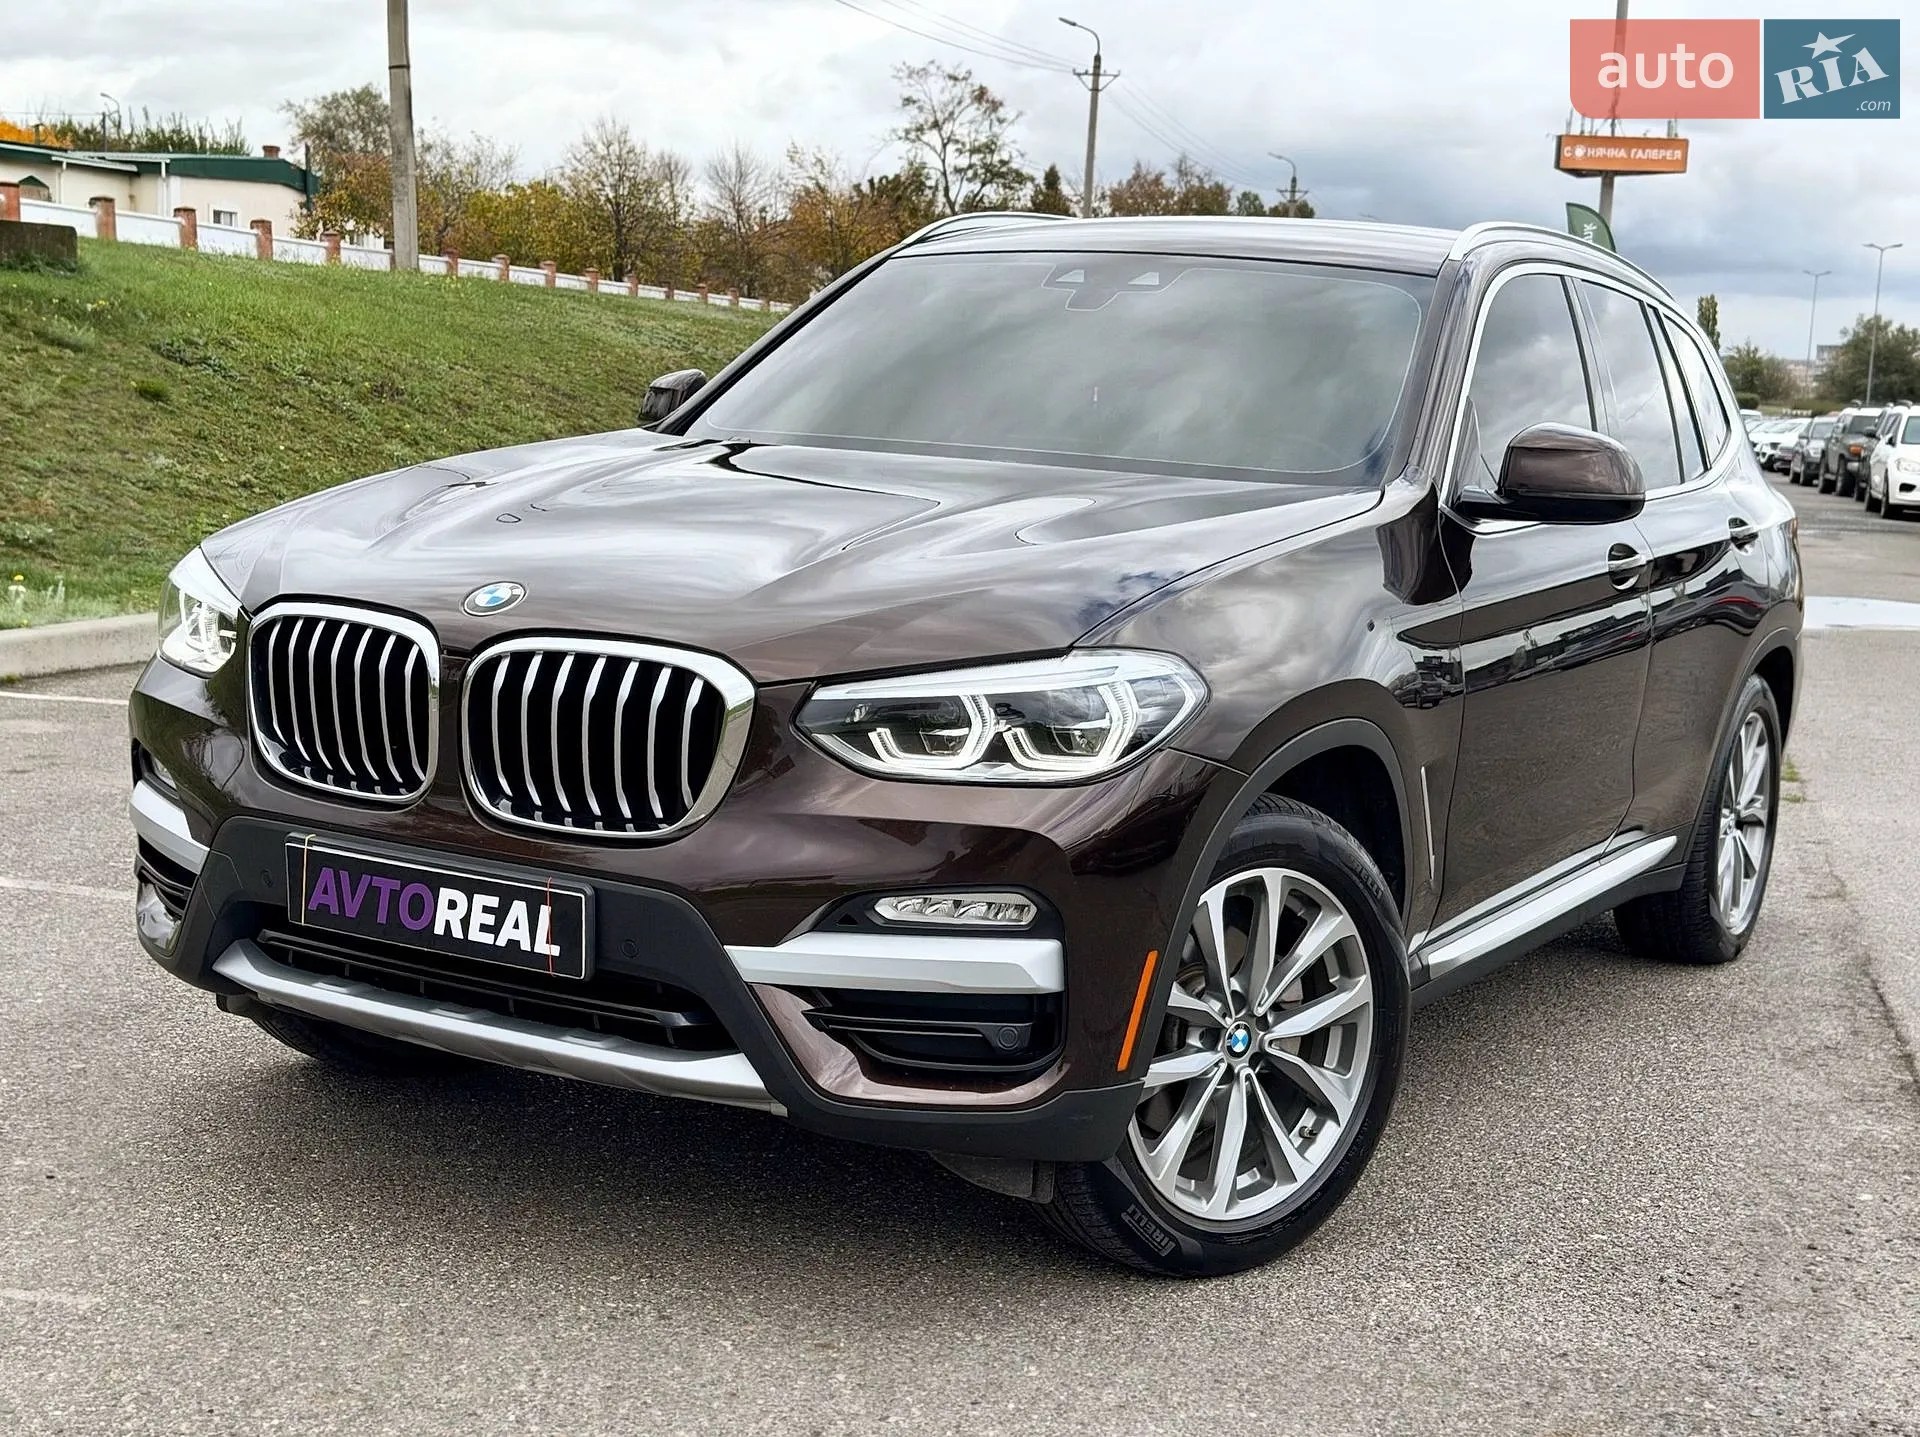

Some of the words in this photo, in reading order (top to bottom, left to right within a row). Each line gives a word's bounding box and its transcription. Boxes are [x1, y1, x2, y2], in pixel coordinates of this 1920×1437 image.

[1630, 147, 1682, 160] ГАЛЕРЕЯ
[308, 866, 561, 957] AVTOREAL
[1121, 1203, 1177, 1257] PIRELLI
